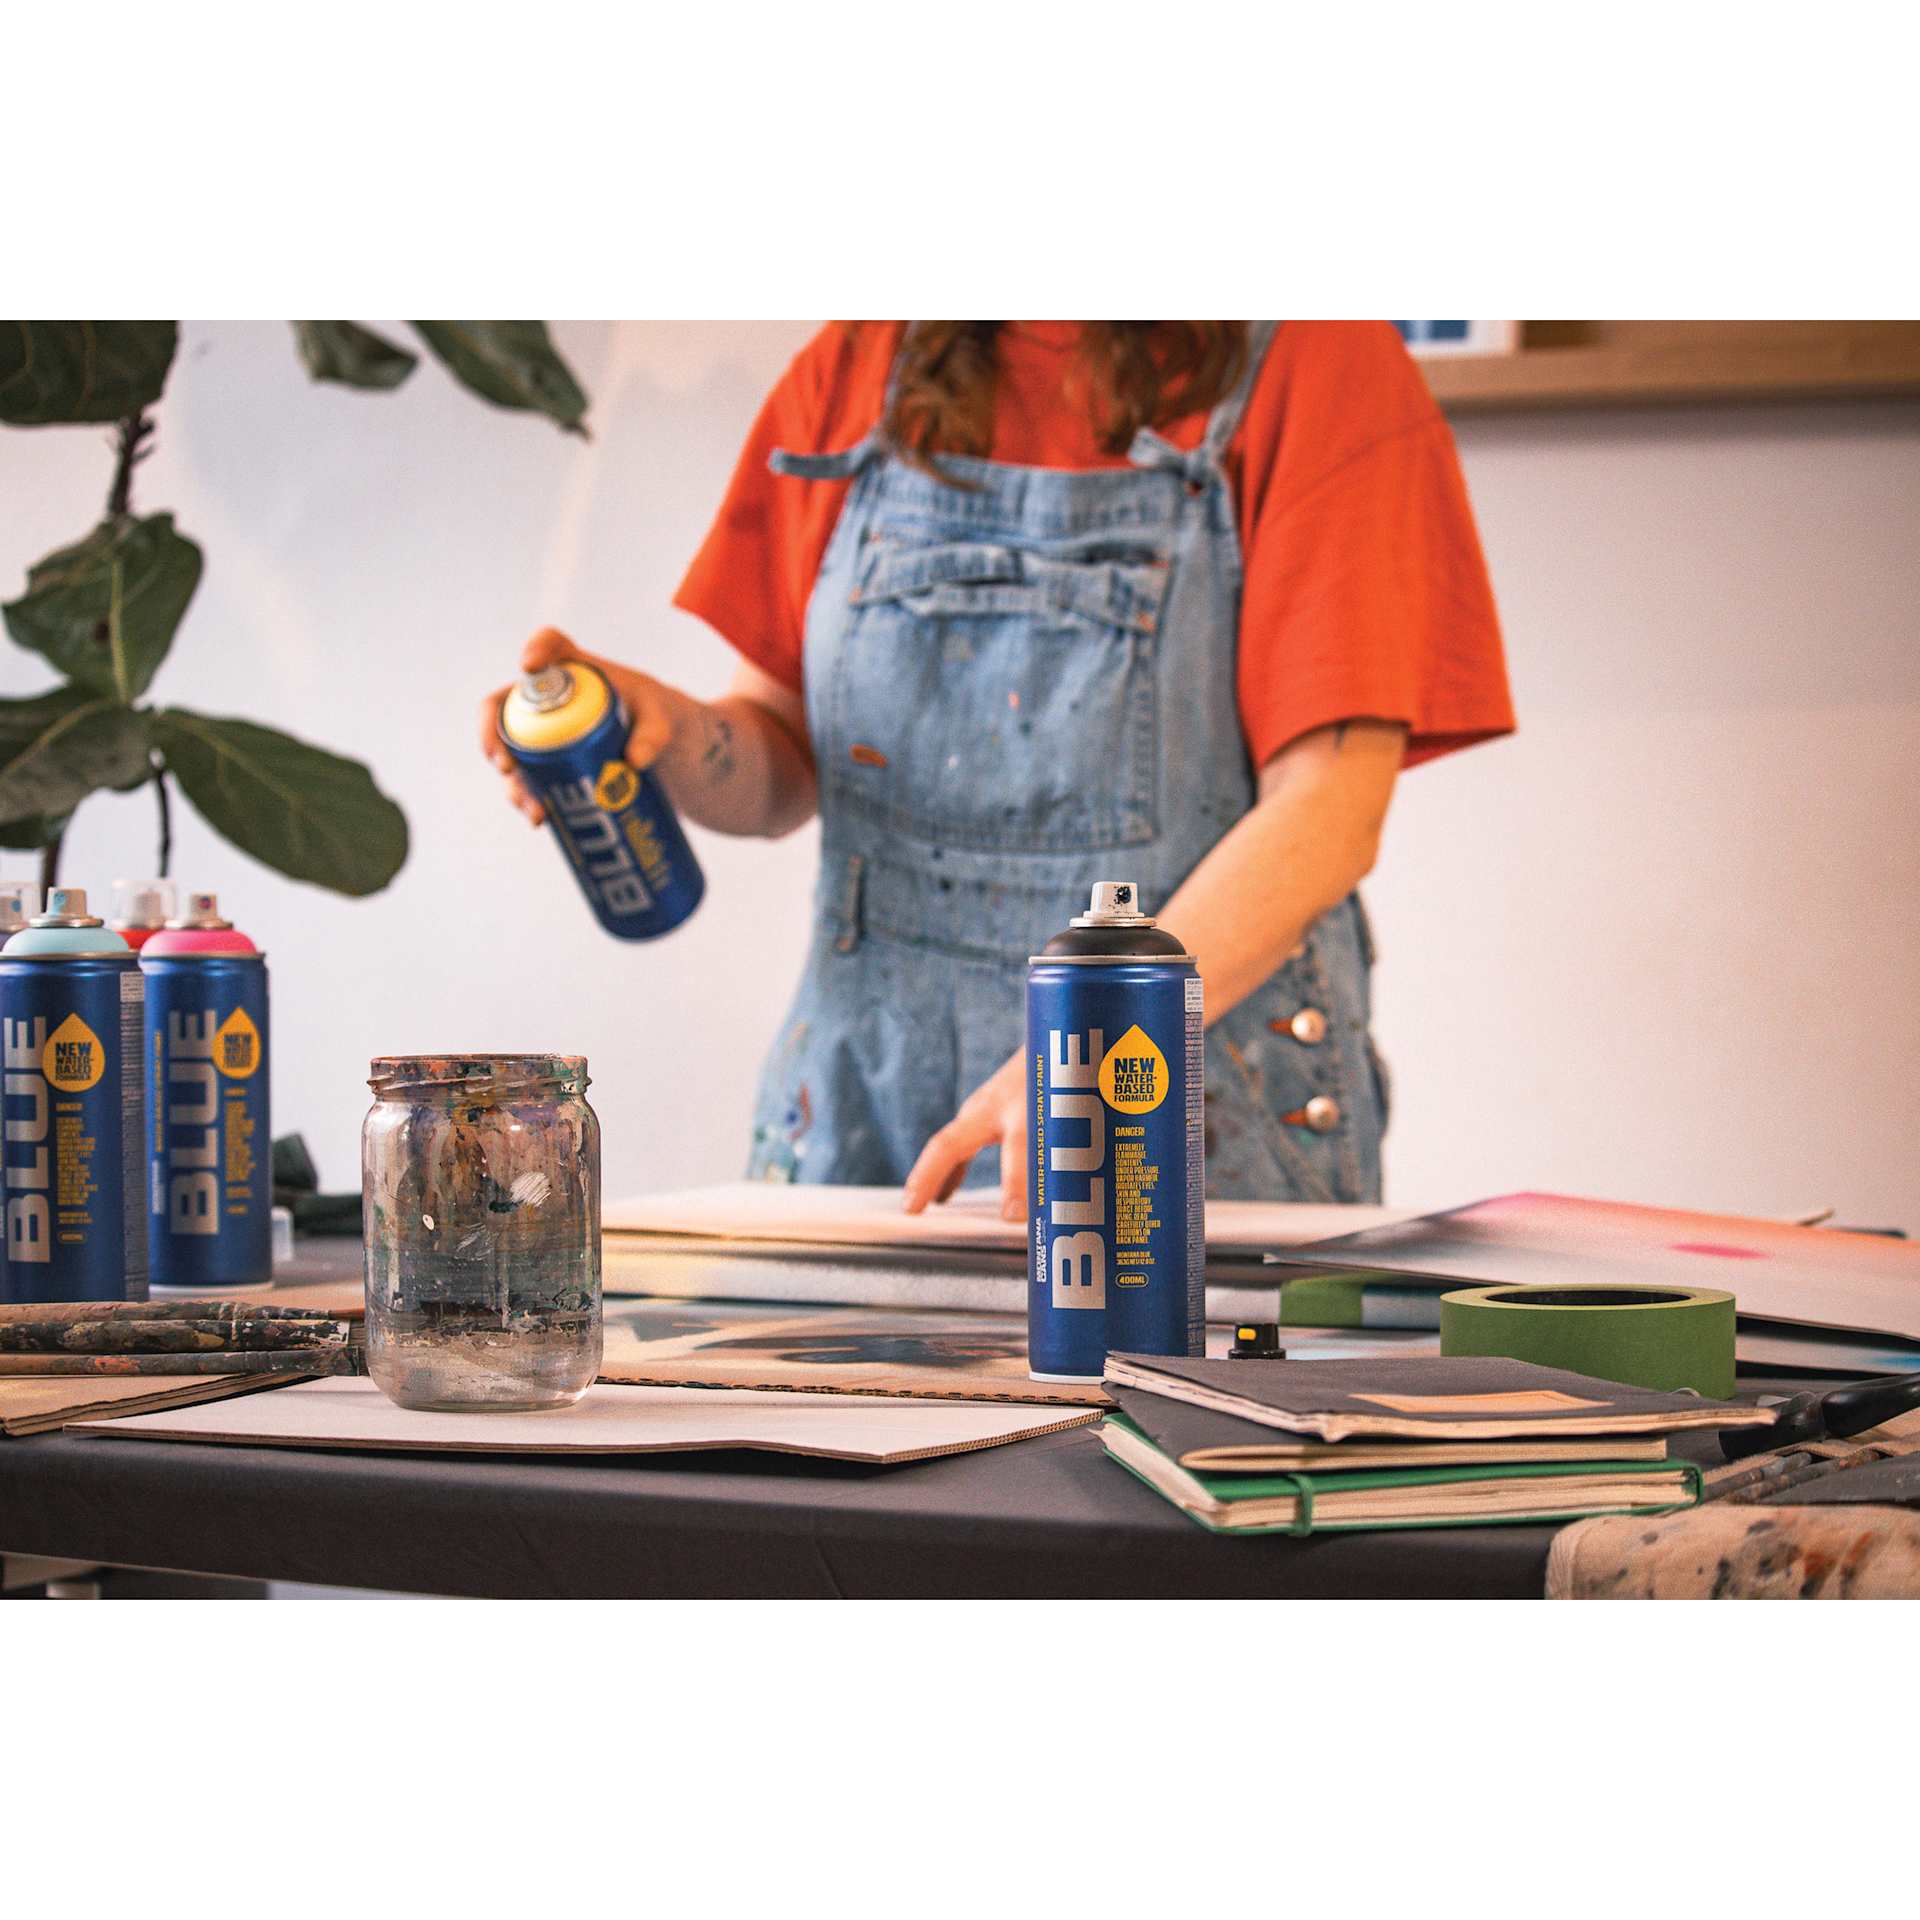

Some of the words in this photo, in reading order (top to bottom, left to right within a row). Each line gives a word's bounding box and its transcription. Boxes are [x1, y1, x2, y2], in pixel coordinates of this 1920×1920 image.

[224, 1034, 252, 1044] NEW
[56, 1042, 92, 1056] NEW
[1036, 1054, 1044, 1087] PAINT
[1114, 1058, 1155, 1073] NEW
[1114, 1074, 1157, 1084] WATER-
[1114, 1084, 1155, 1094] BASED
[1114, 1094, 1155, 1102] FORMULA
[1037, 1090, 1045, 1126] SPRAY
[169, 1009, 219, 1235] BLUE
[4, 1016, 51, 1264] BLUE
[1037, 1128, 1045, 1206] WATER-BASED
[1050, 1029, 1106, 1309] BLUE
[1119, 1276, 1145, 1284] 400ML
